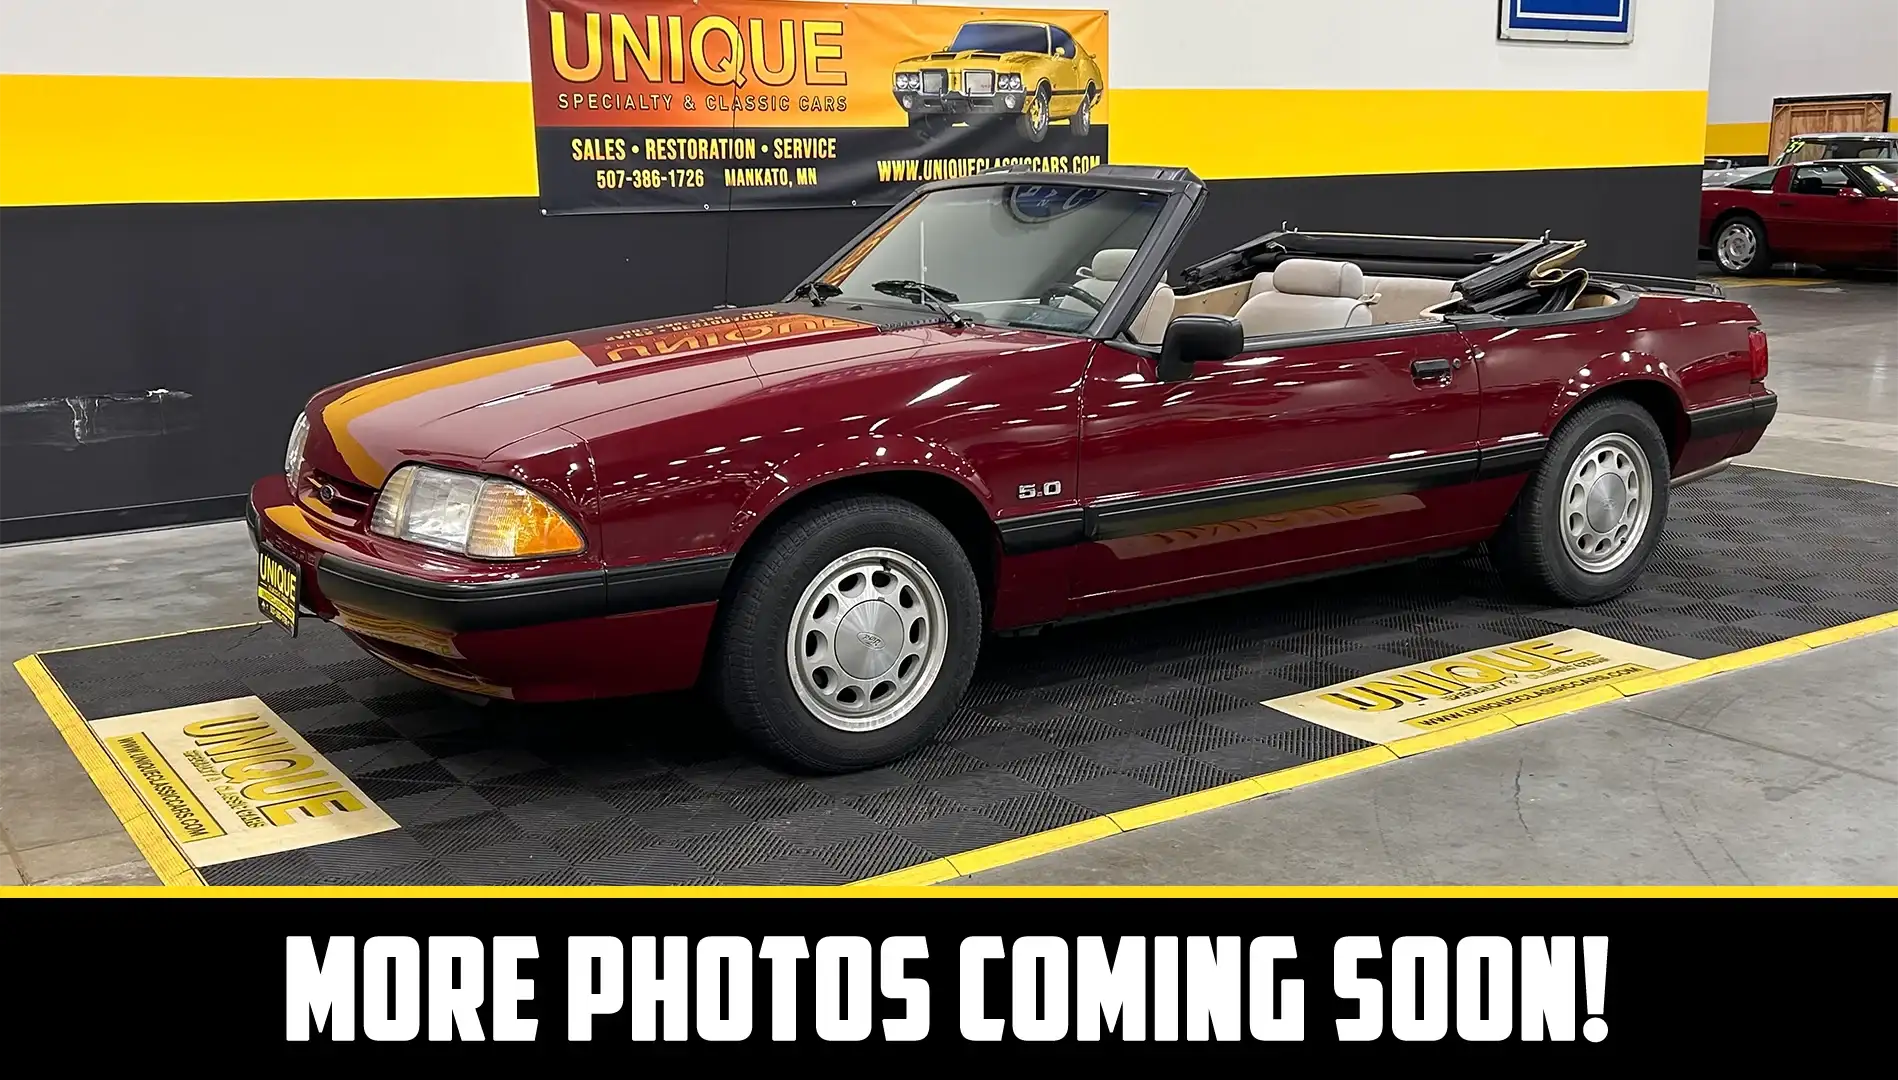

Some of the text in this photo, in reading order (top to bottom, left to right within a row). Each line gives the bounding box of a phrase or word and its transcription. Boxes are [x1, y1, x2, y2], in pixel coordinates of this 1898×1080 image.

[549, 10, 848, 87] UNIQUE
[558, 93, 847, 111] SPECIALTY & CLASSIC CARS
[571, 138, 837, 161] SALES RESTORATION SERVICE
[597, 167, 818, 189] 507-386-1726 MANKATO, MN
[1018, 481, 1062, 499] 5.0
[260, 553, 297, 602] UNIQUE
[1318, 639, 1602, 712] UNIQUE
[117, 736, 209, 838] WWW.UNIQUECLASSICCARS.COM
[183, 712, 367, 828] UNIQUE
